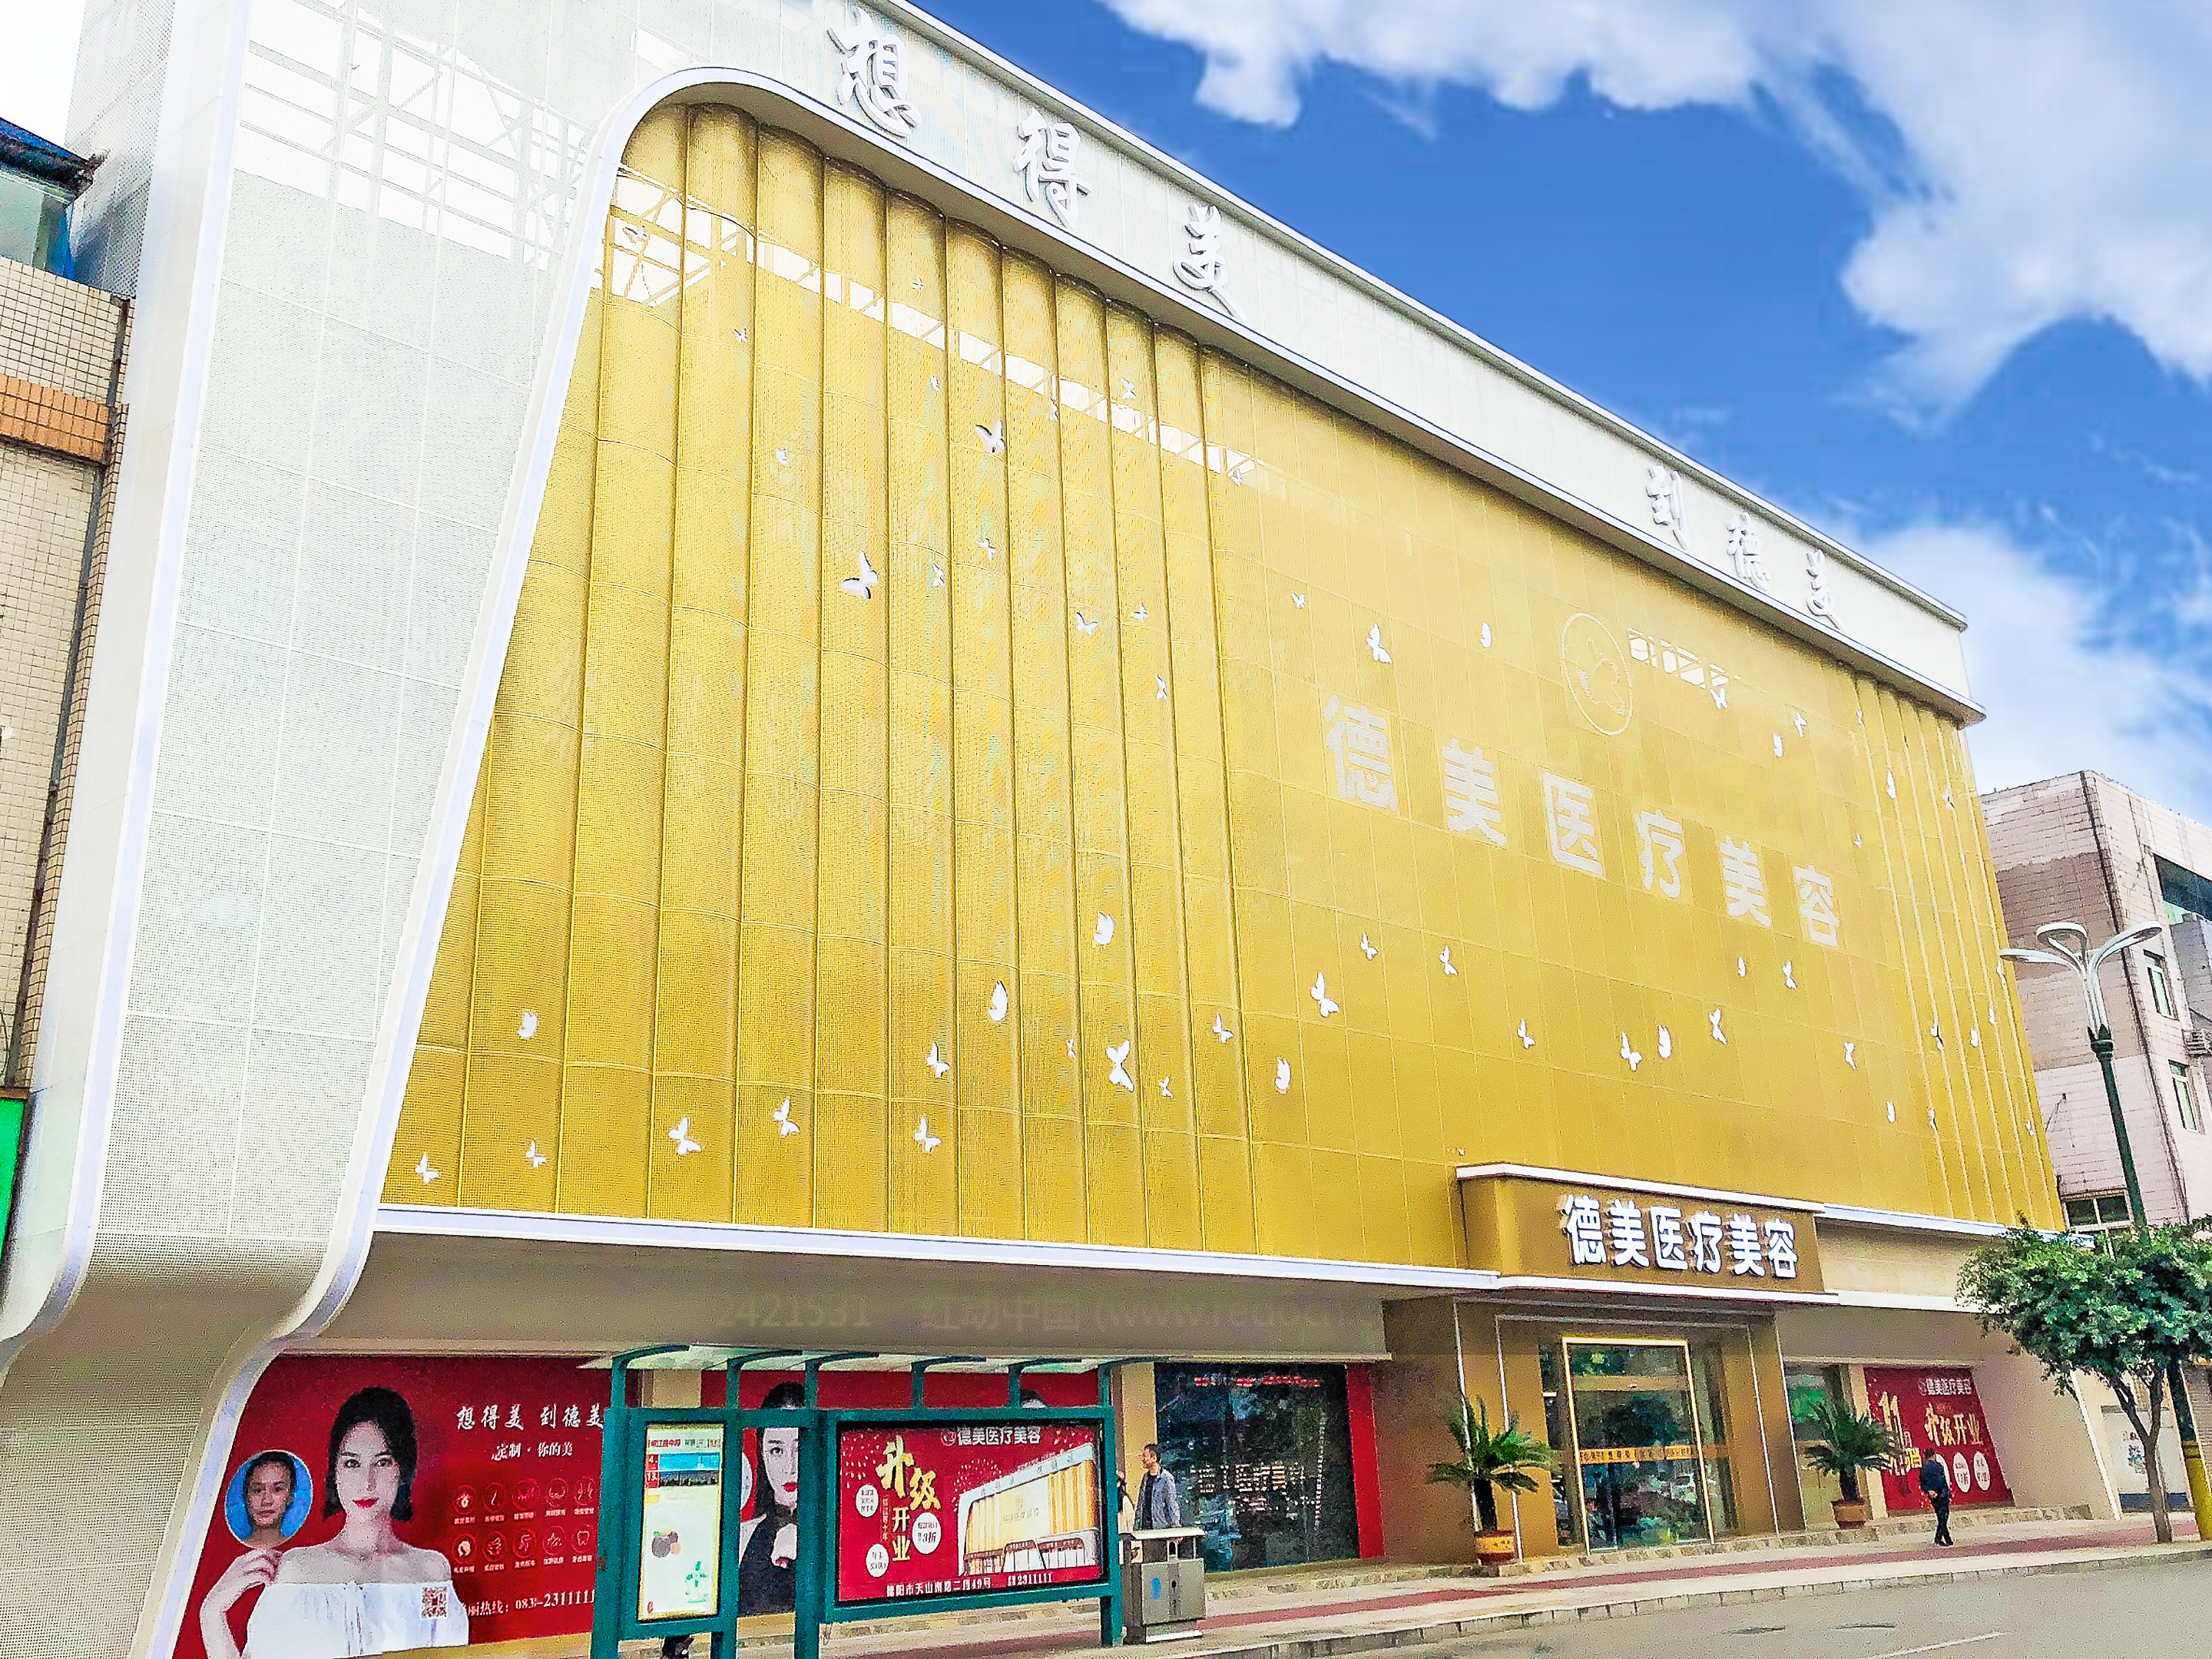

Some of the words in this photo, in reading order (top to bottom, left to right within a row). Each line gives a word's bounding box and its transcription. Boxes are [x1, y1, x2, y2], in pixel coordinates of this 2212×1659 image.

[827, 6, 1246, 322] 想得美
[1323, 694, 1839, 949] 德美医疗美容
[1564, 1194, 1798, 1278] 德美医疗美容
[456, 1404, 524, 1430] 想得美
[540, 1403, 604, 1429] 到德美
[957, 1426, 1041, 1445] 德美医疗美容
[892, 1506, 910, 1561] 开业
